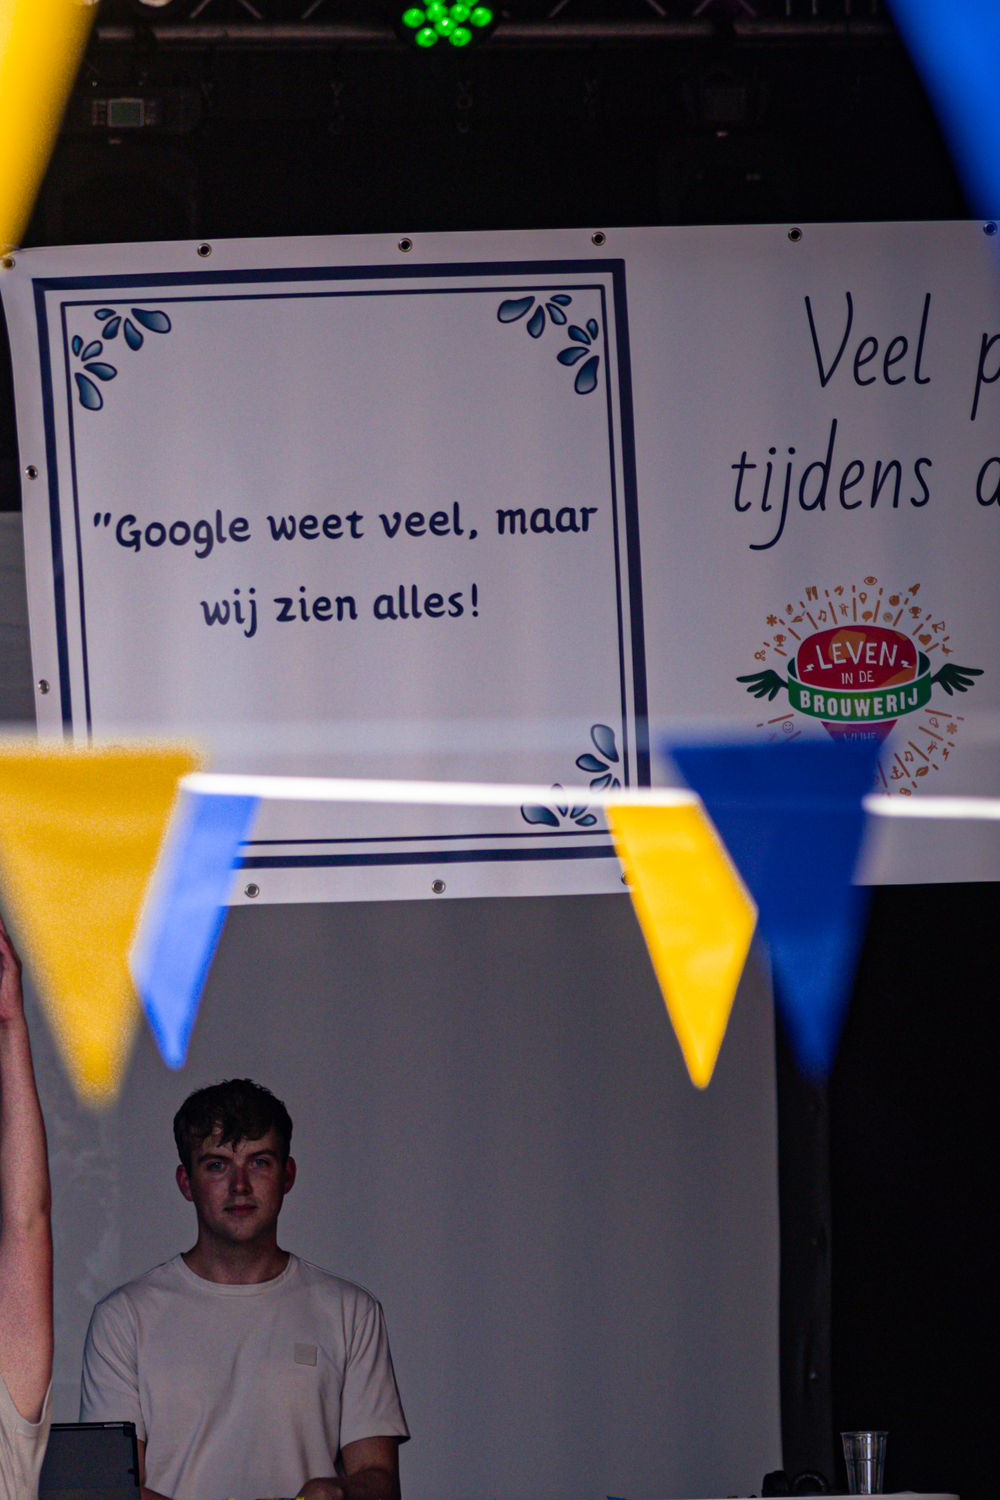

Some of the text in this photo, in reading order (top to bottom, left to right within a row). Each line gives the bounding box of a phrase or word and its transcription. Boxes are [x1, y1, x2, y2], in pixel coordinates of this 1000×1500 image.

[804, 291, 932, 388] Veel
[731, 418, 933, 551] tijdens
[93, 501, 599, 560] "Google weet veel, maar
[200, 583, 479, 639] wij zien alles!
[815, 641, 898, 670] LEVEN
[841, 671, 875, 684] IN DE
[800, 688, 918, 717] BROUWERIJ
